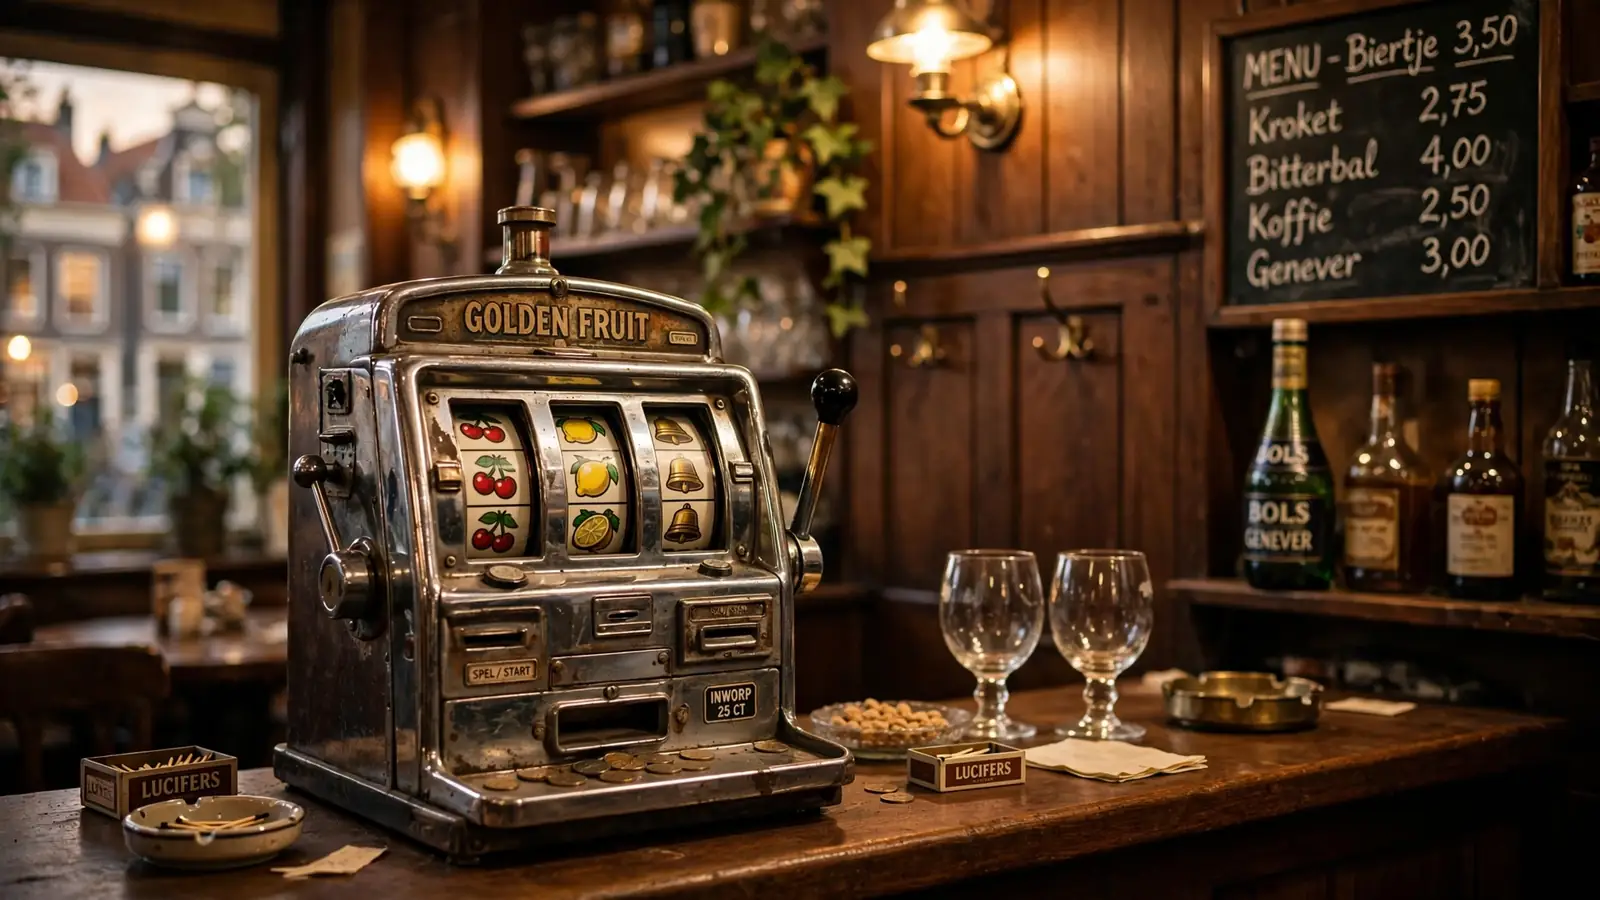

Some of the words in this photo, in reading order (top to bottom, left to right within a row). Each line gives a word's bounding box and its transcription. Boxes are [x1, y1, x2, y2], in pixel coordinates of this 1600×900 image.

[1243, 43, 1321, 90] MENU
[1345, 29, 1439, 76] Biertje
[1453, 14, 1518, 57] 3,50
[1249, 99, 1343, 146] Kroket
[1418, 80, 1488, 127] 2,75
[1246, 138, 1379, 196] Bitterbal
[1419, 134, 1491, 179] 4,00
[1249, 197, 1334, 247] Koffie
[1418, 184, 1490, 228] 2,50
[1246, 248, 1363, 290] Genever
[1420, 234, 1491, 279] 3,00
[464, 300, 569, 338] GOLDEN
[578, 307, 649, 341] FRUIT
[1248, 501, 1311, 525] BOLS
[1244, 528, 1313, 550] GENEVER
[472, 668, 495, 680] SPEL
[503, 665, 531, 677] START
[710, 688, 752, 704] INWORP
[717, 705, 730, 718] 25
[734, 703, 746, 716] CT
[955, 761, 1012, 779] LUCIFERS
[141, 771, 221, 799] LUCIFERS
